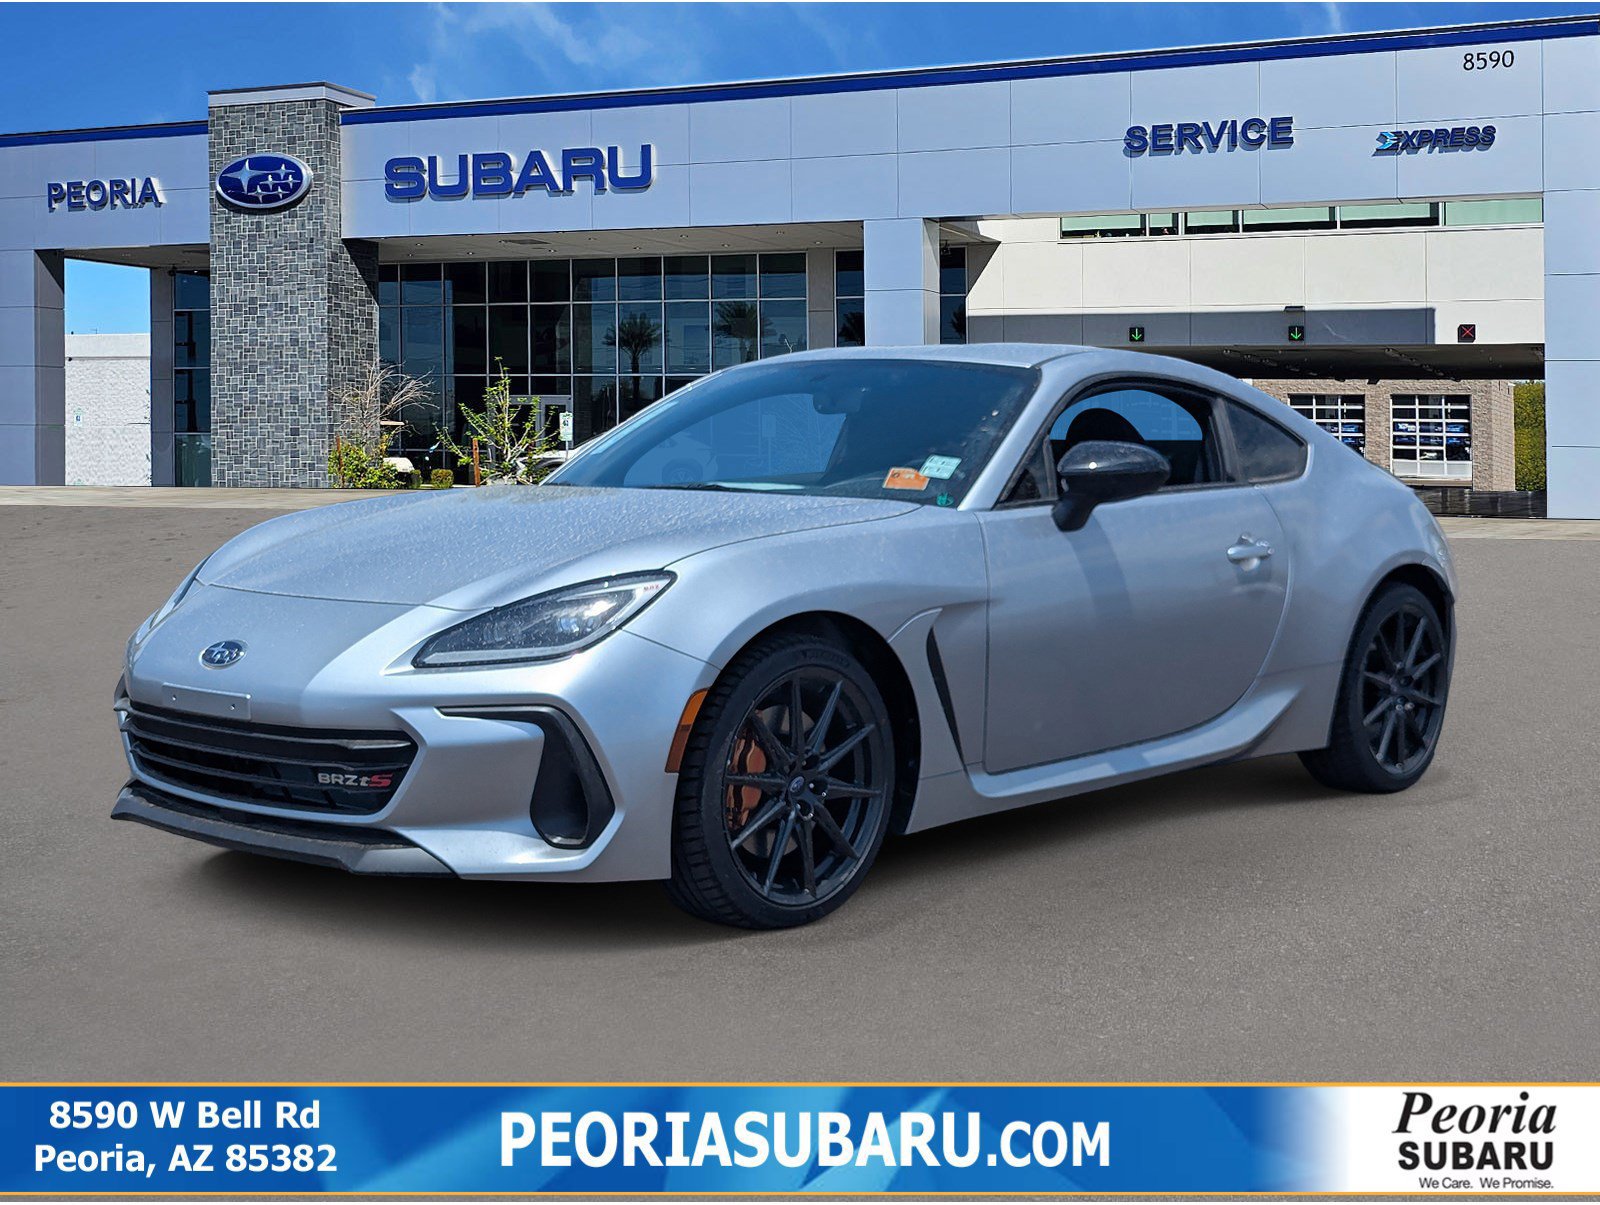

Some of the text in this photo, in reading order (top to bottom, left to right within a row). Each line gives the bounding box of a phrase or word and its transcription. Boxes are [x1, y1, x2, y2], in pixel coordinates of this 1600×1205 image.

[1462, 50, 1514, 71] 8590
[1124, 116, 1294, 153] SERVICE
[1376, 125, 1497, 152] EXPRESS
[384, 143, 654, 201] SUBARU
[47, 177, 164, 211] PEORIA
[317, 773, 358, 786] BRZ
